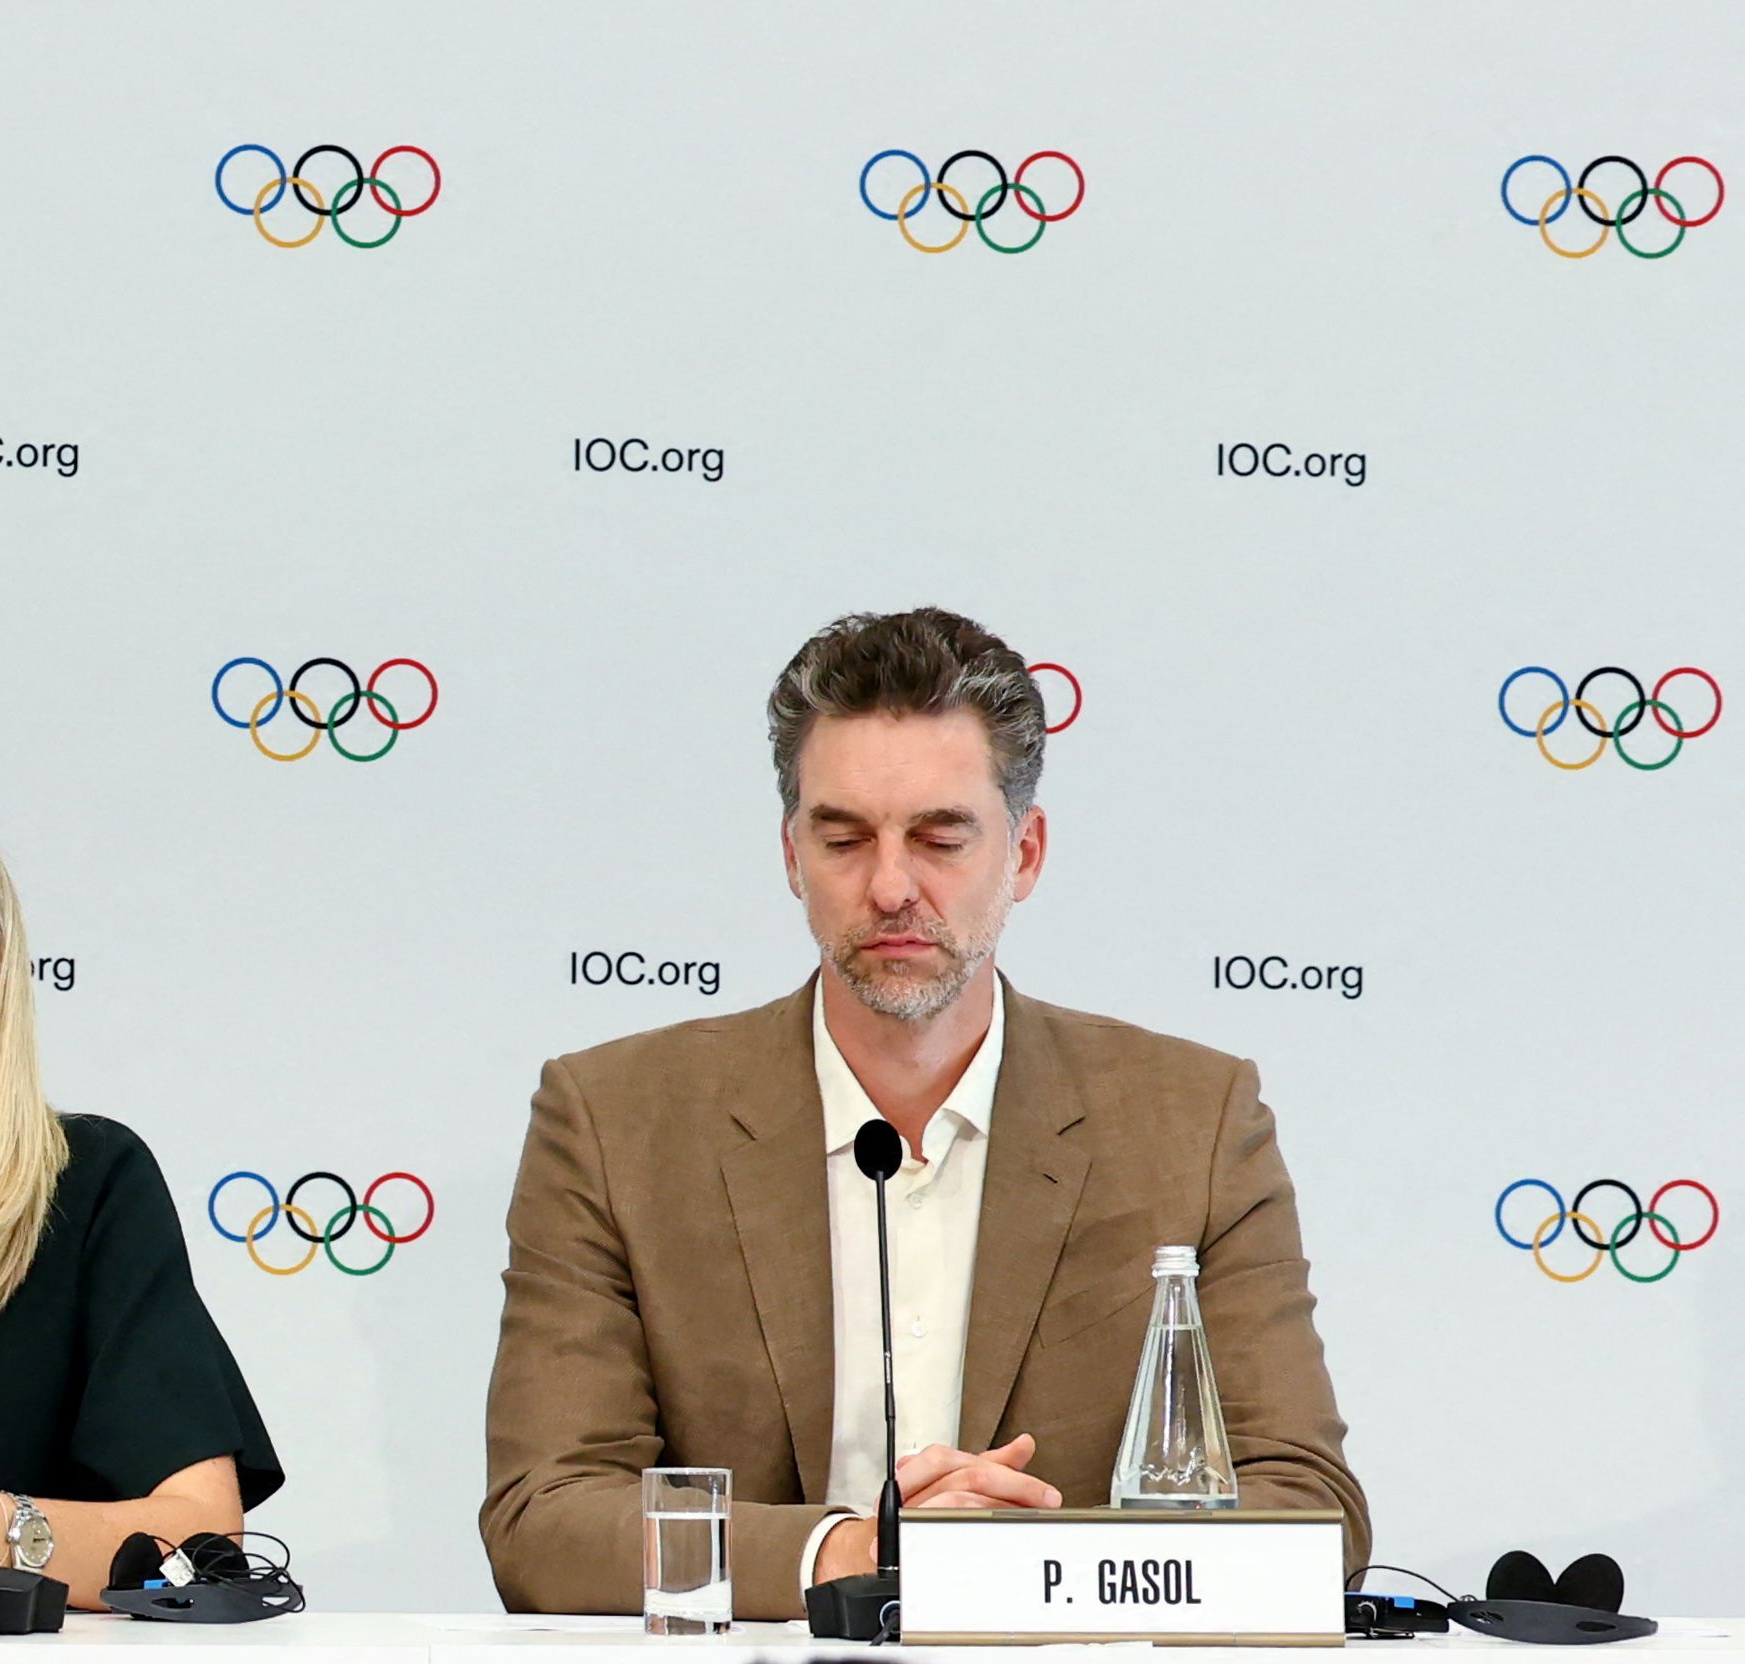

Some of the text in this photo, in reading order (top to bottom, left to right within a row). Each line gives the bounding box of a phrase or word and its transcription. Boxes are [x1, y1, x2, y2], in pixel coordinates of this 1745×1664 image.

[574, 437, 723, 482] IOC.org
[1217, 442, 1366, 487] IOC.org
[571, 951, 721, 996] IOC.org
[1214, 955, 1363, 1000] IOC.org
[1043, 1559, 1202, 1605] P. GASOL
